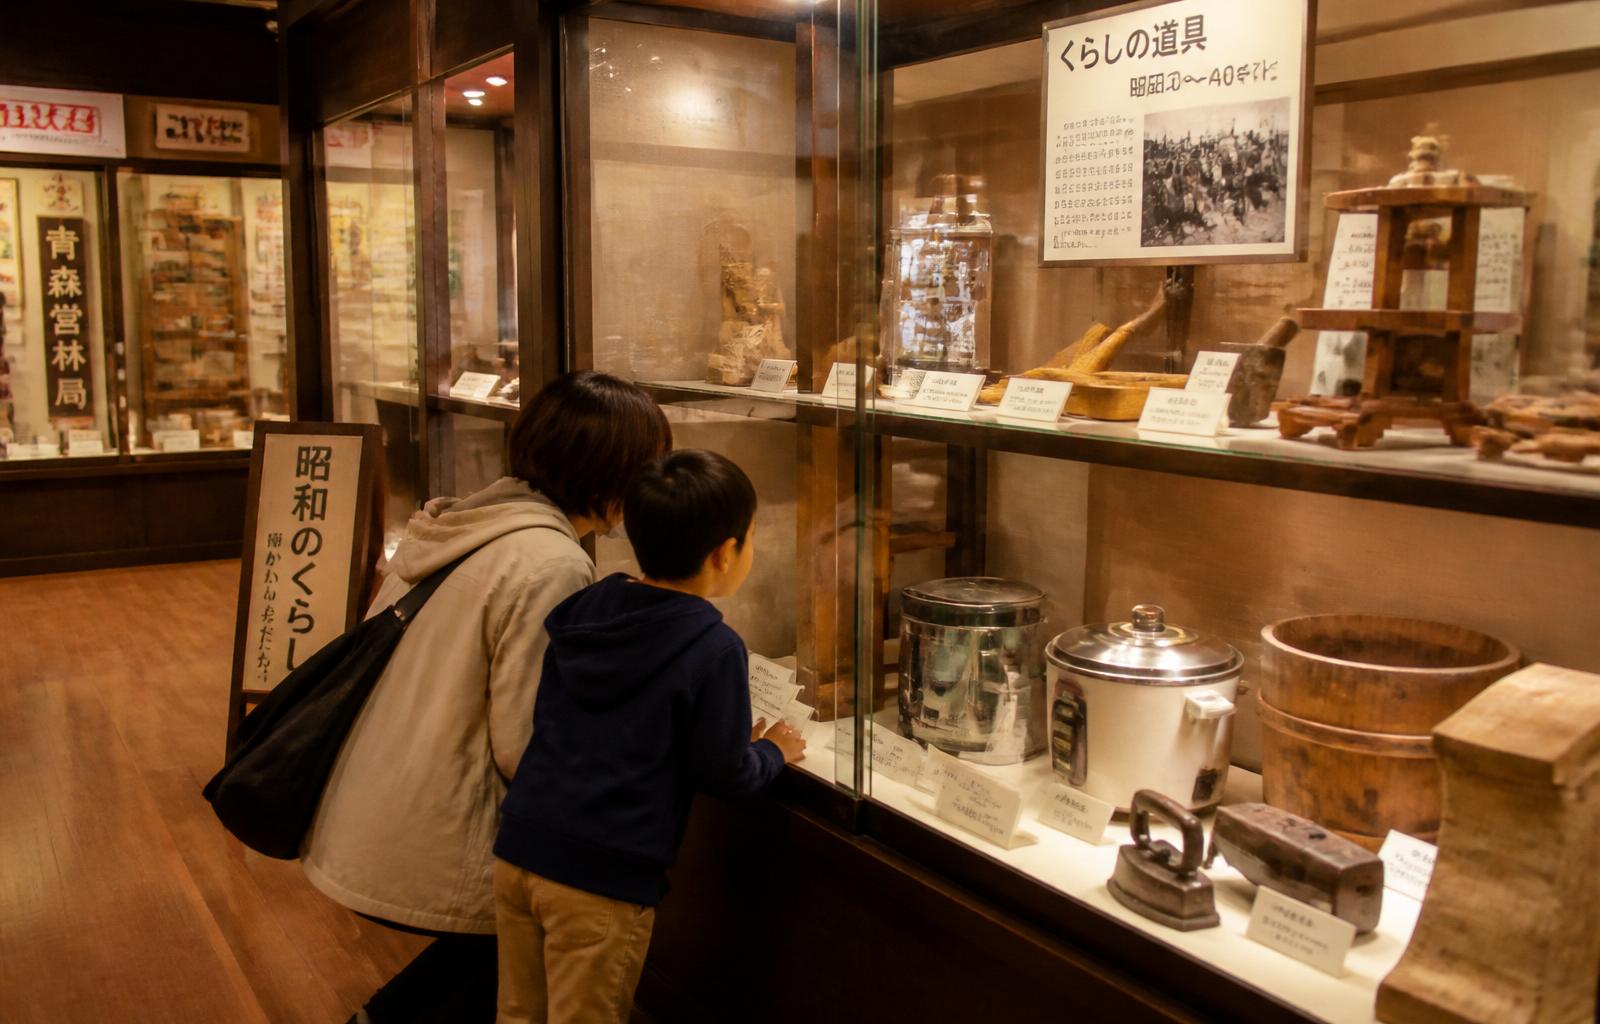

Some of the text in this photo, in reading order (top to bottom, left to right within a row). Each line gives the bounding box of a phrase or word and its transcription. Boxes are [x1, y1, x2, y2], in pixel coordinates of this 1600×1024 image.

[1060, 14, 1208, 72] くらしの道具
[46, 225, 87, 411] 青森営林局
[287, 445, 333, 672] 昭和のくらし
